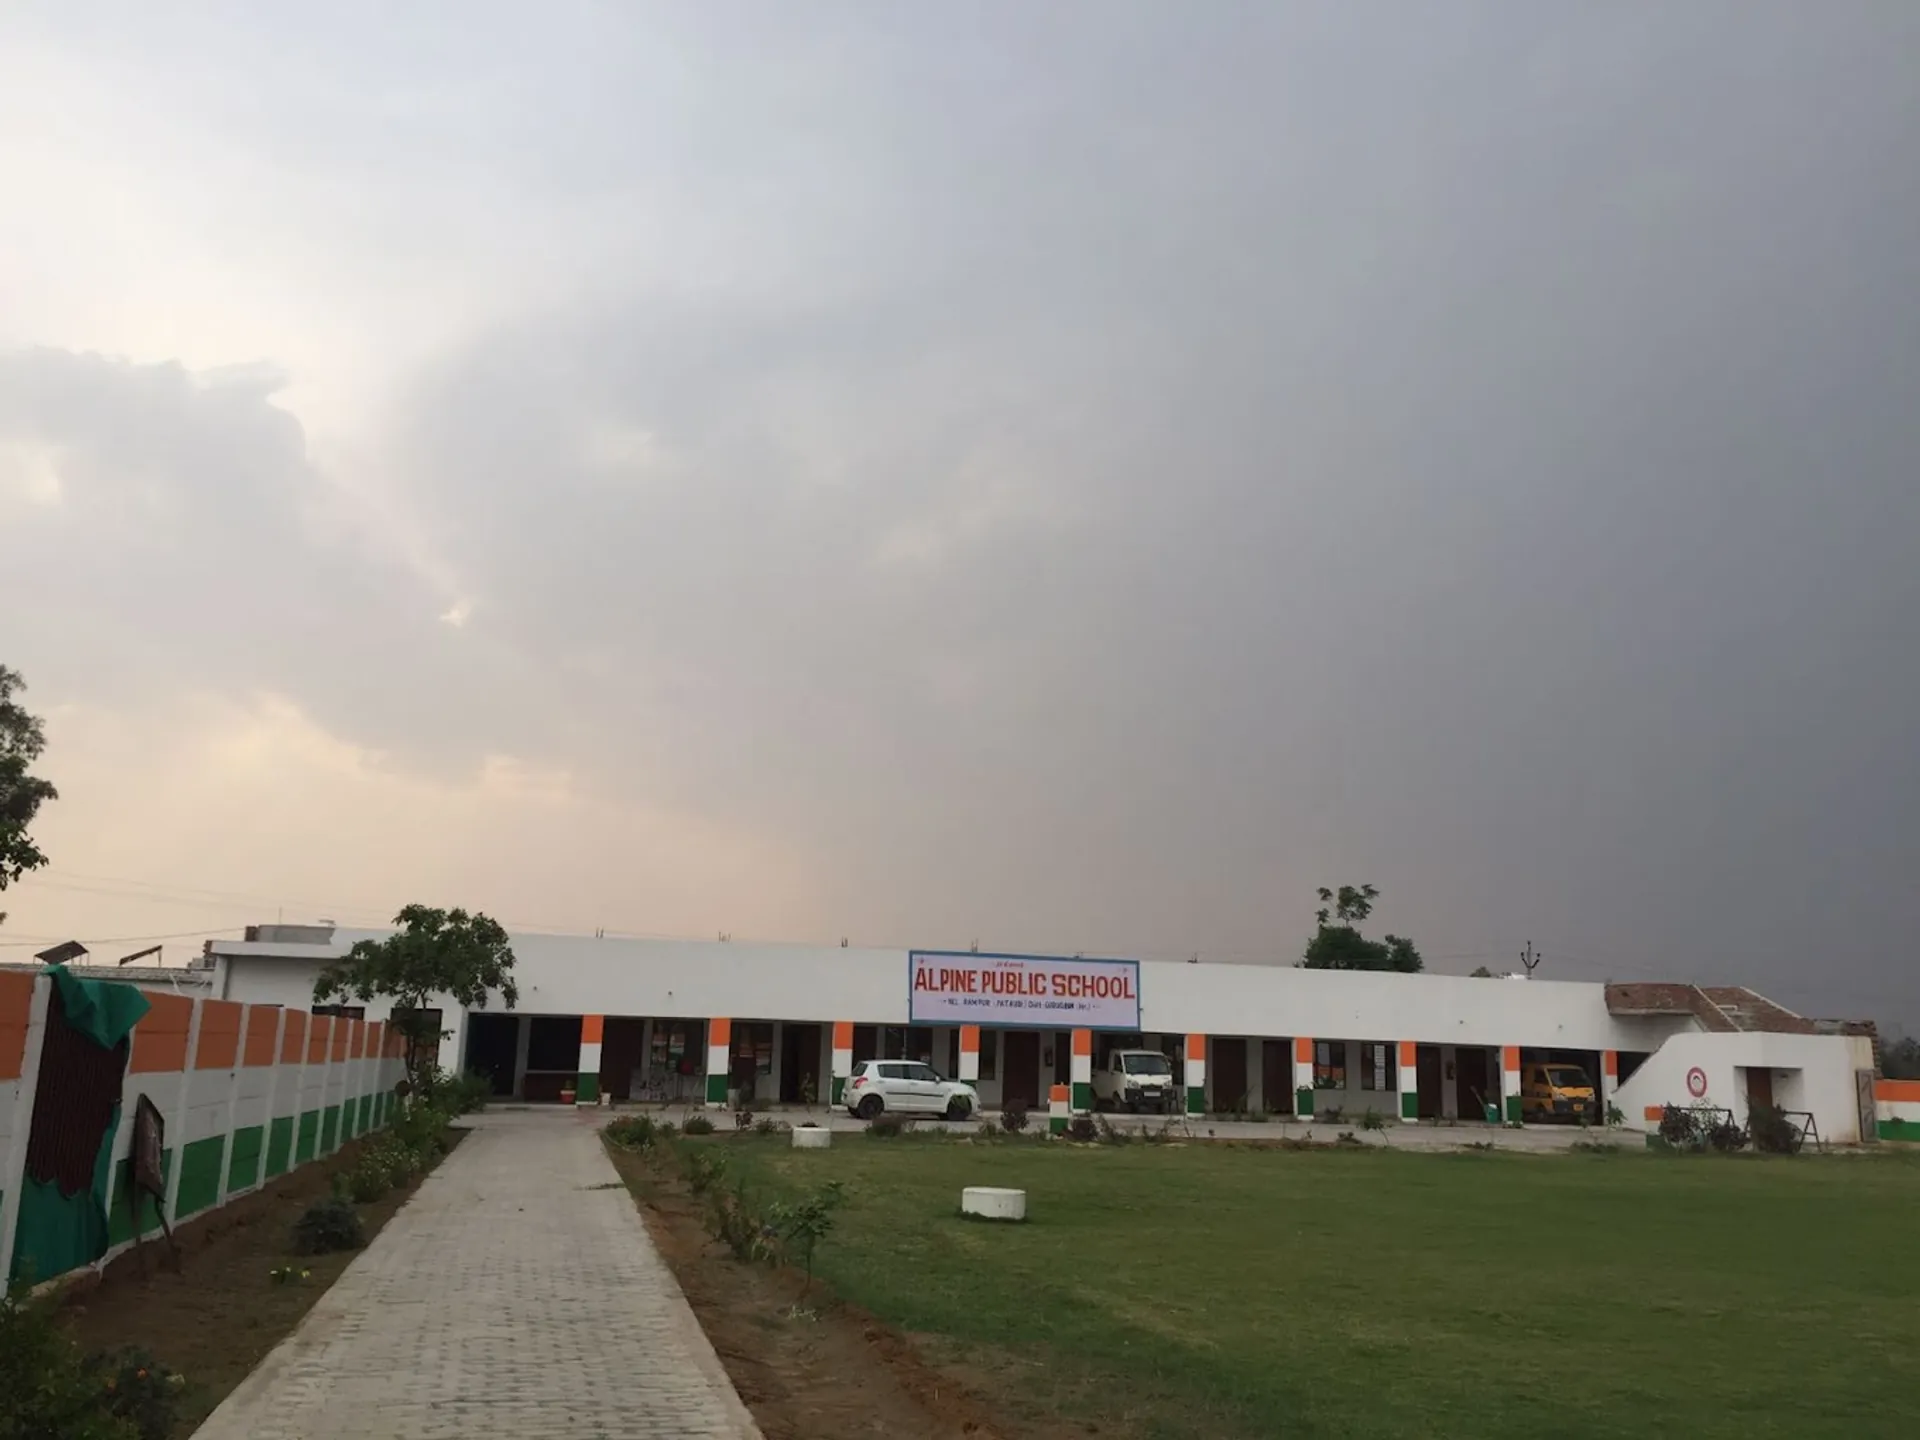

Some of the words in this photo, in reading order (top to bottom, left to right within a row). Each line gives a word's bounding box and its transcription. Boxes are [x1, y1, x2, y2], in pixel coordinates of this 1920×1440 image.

[914, 967, 978, 993] ALPINE
[981, 971, 1047, 995] PUBLIC
[1051, 973, 1136, 999] SCHOOL
